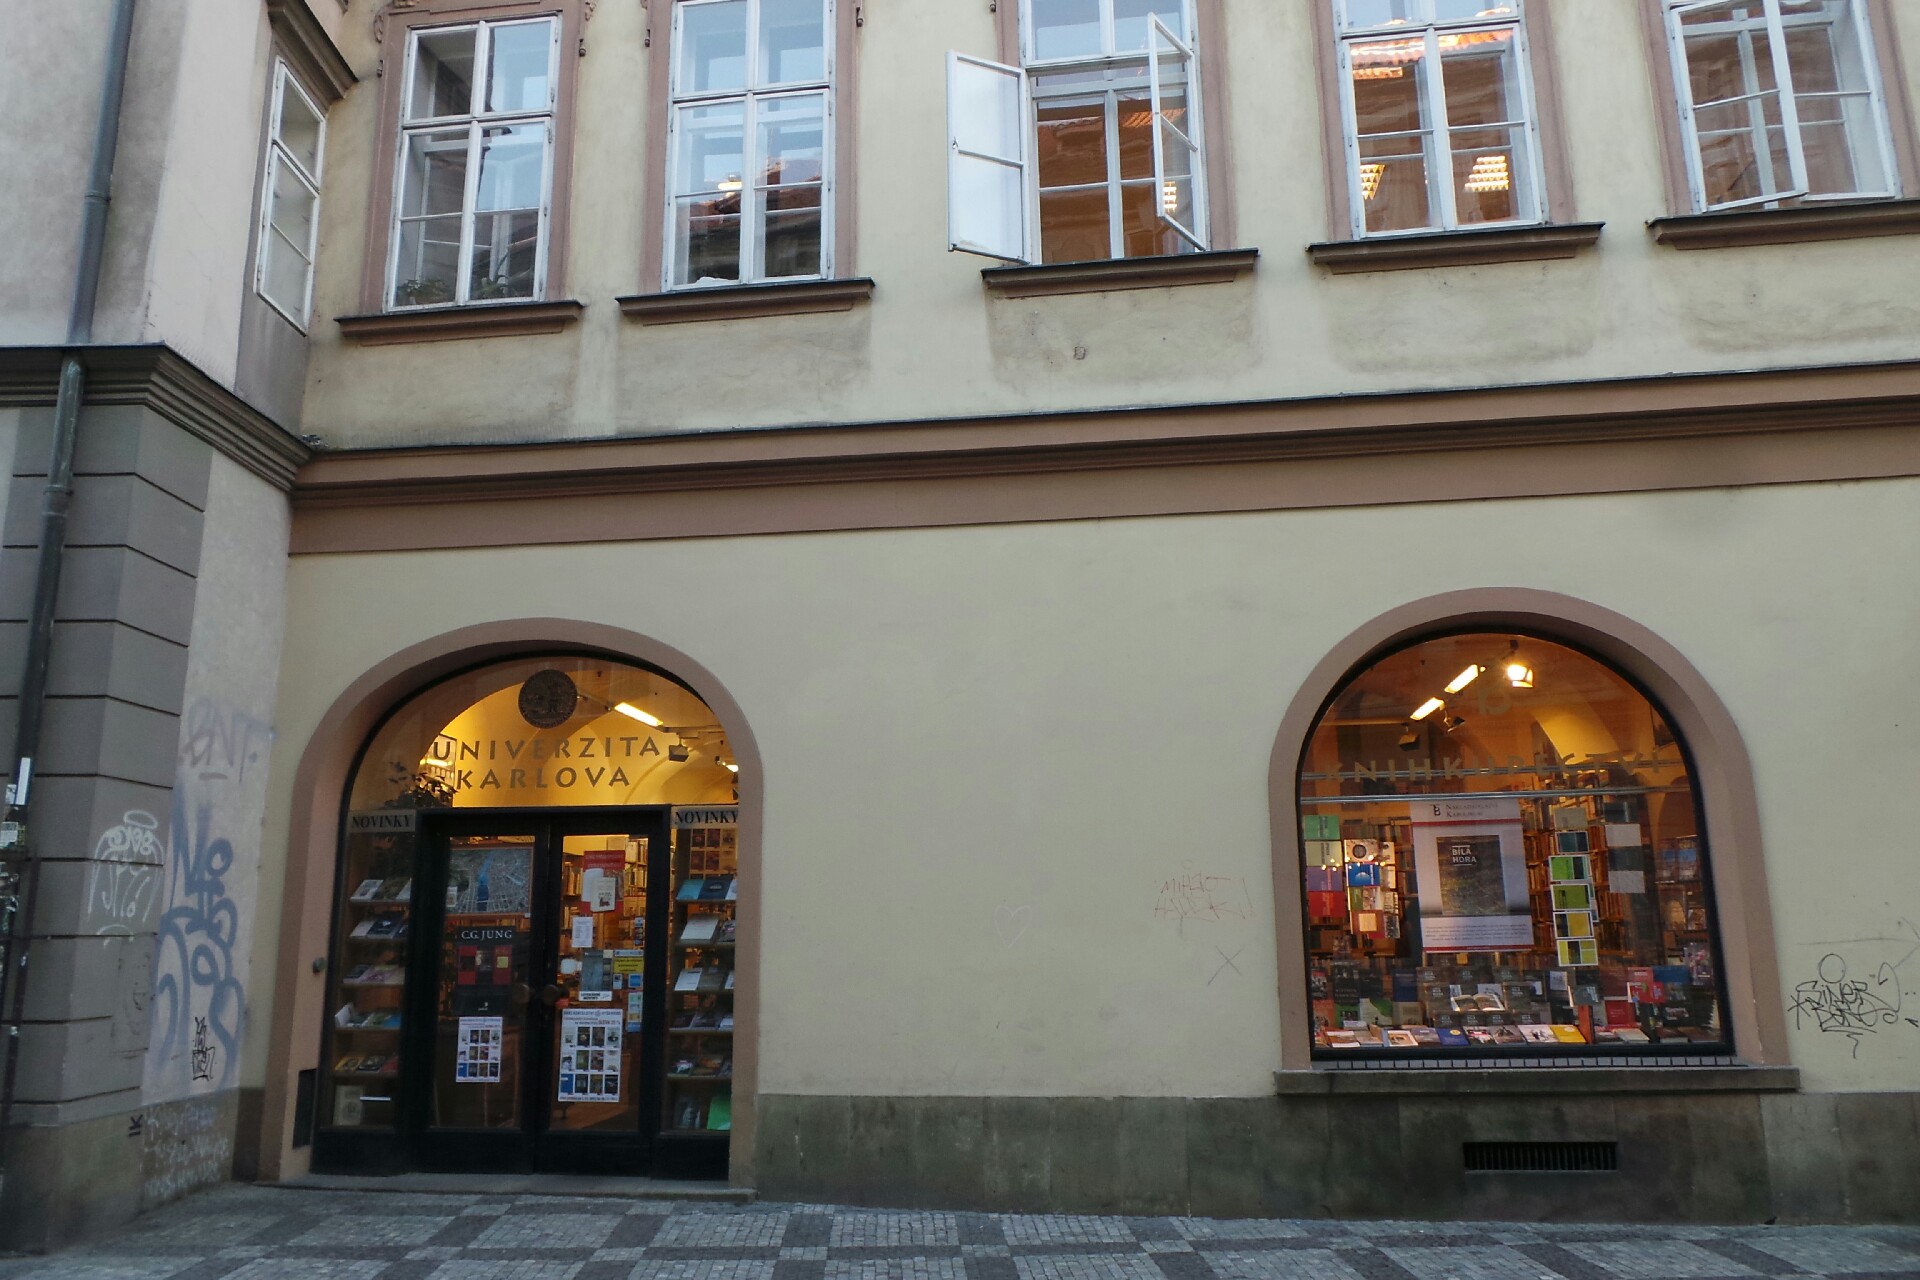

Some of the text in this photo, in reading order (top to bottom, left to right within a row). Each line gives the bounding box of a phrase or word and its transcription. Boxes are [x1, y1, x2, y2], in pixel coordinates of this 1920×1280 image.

[433, 736, 660, 761] UNIVERZITA
[457, 766, 630, 789] KARLOVA
[351, 814, 413, 828] NOVINKY
[674, 810, 738, 824] NOVINKY
[481, 930, 512, 941] JUNG
